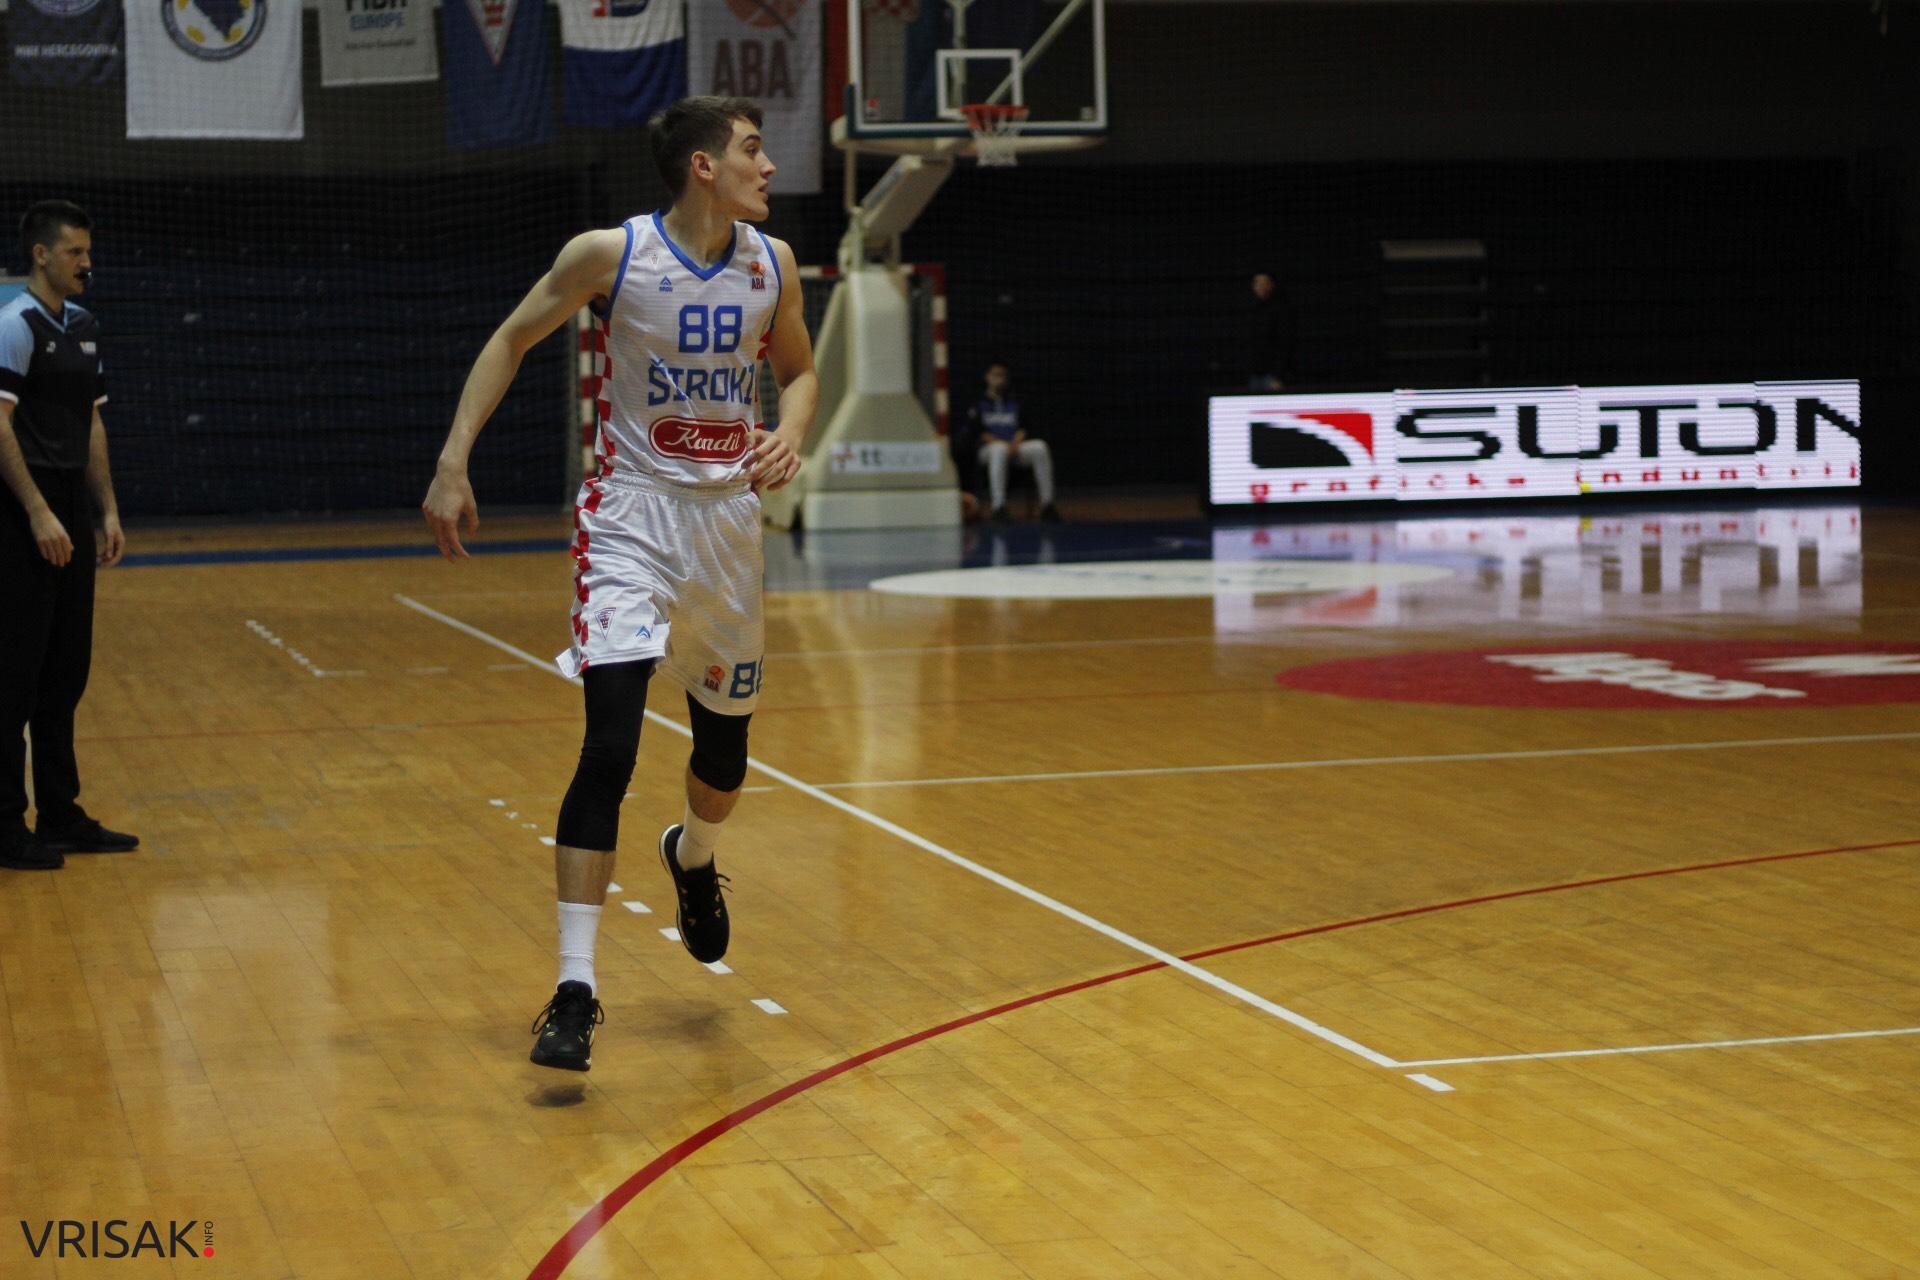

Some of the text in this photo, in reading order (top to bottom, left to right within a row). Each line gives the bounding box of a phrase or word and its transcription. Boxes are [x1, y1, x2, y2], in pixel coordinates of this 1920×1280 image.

[713, 38, 793, 99] ABA
[751, 277, 766, 291] ABA
[678, 304, 743, 353] 88
[648, 357, 756, 407] ŠIROKI
[1395, 396, 1861, 463] SUTON
